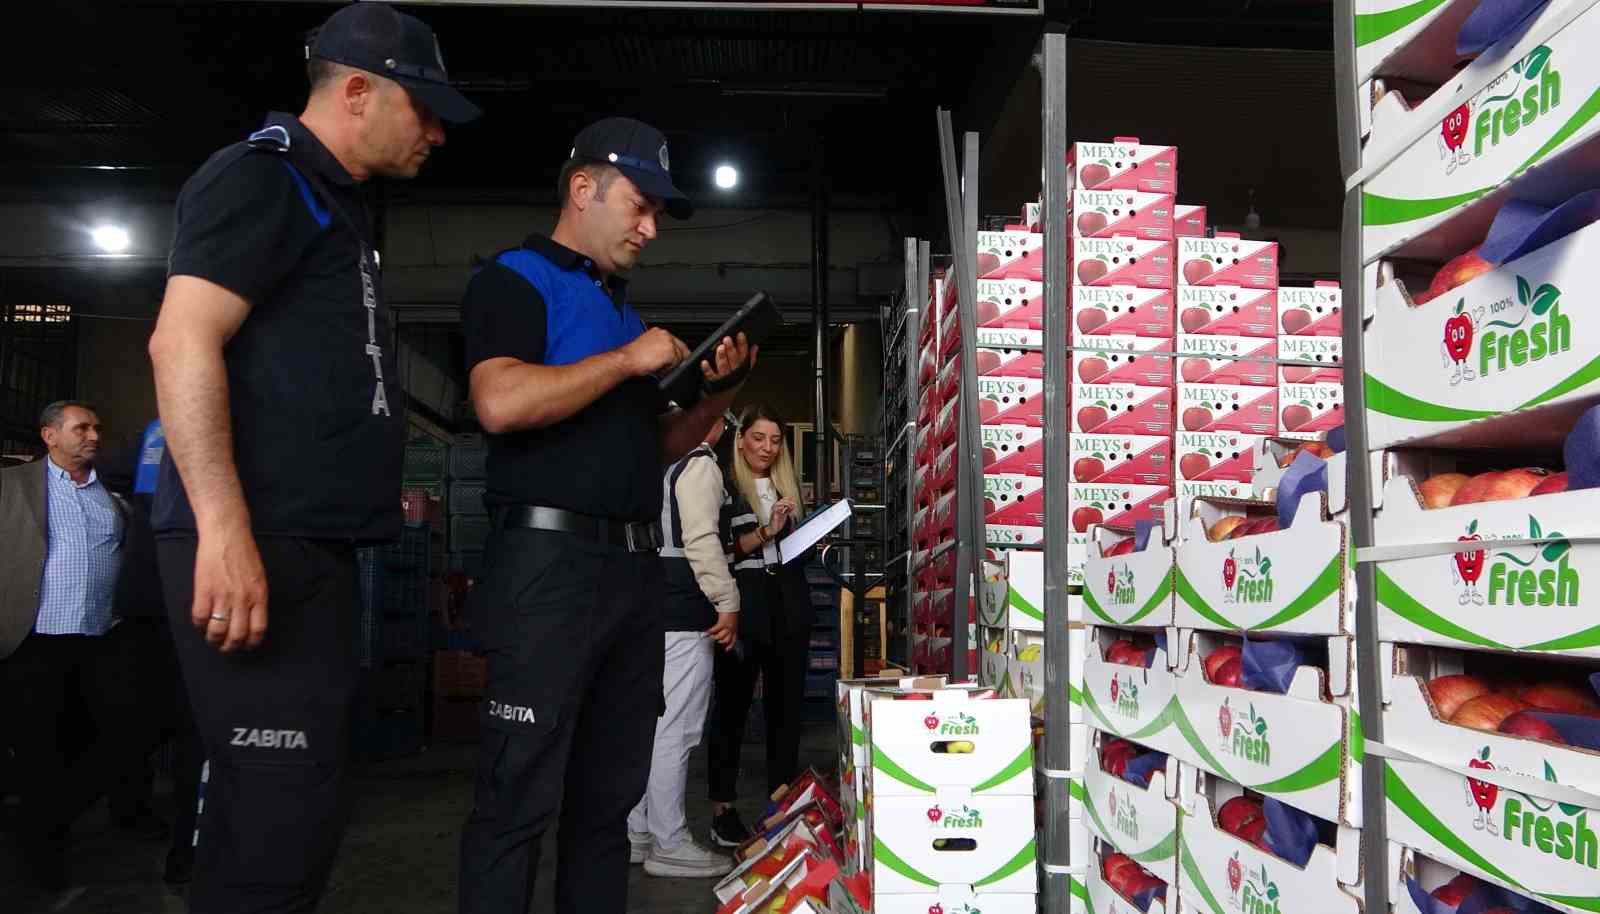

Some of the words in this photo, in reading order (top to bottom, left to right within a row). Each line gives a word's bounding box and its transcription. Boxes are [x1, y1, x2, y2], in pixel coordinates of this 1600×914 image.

[1474, 61, 1560, 158] Fresh
[1490, 296, 1514, 314] 100%
[1480, 301, 1571, 377] Fresh
[984, 429, 1012, 441] EYS
[984, 479, 1012, 491] EYS
[985, 530, 1012, 543] EYS
[1235, 576, 1273, 603] Fresh
[1488, 555, 1580, 606] Fresh
[489, 700, 536, 723] ZABITA
[230, 728, 308, 749] ZABITA
[940, 723, 980, 736] Fresh
[1233, 728, 1270, 766] Fresh
[944, 815, 982, 828] Fresh
[1504, 798, 1598, 869] Fresh
